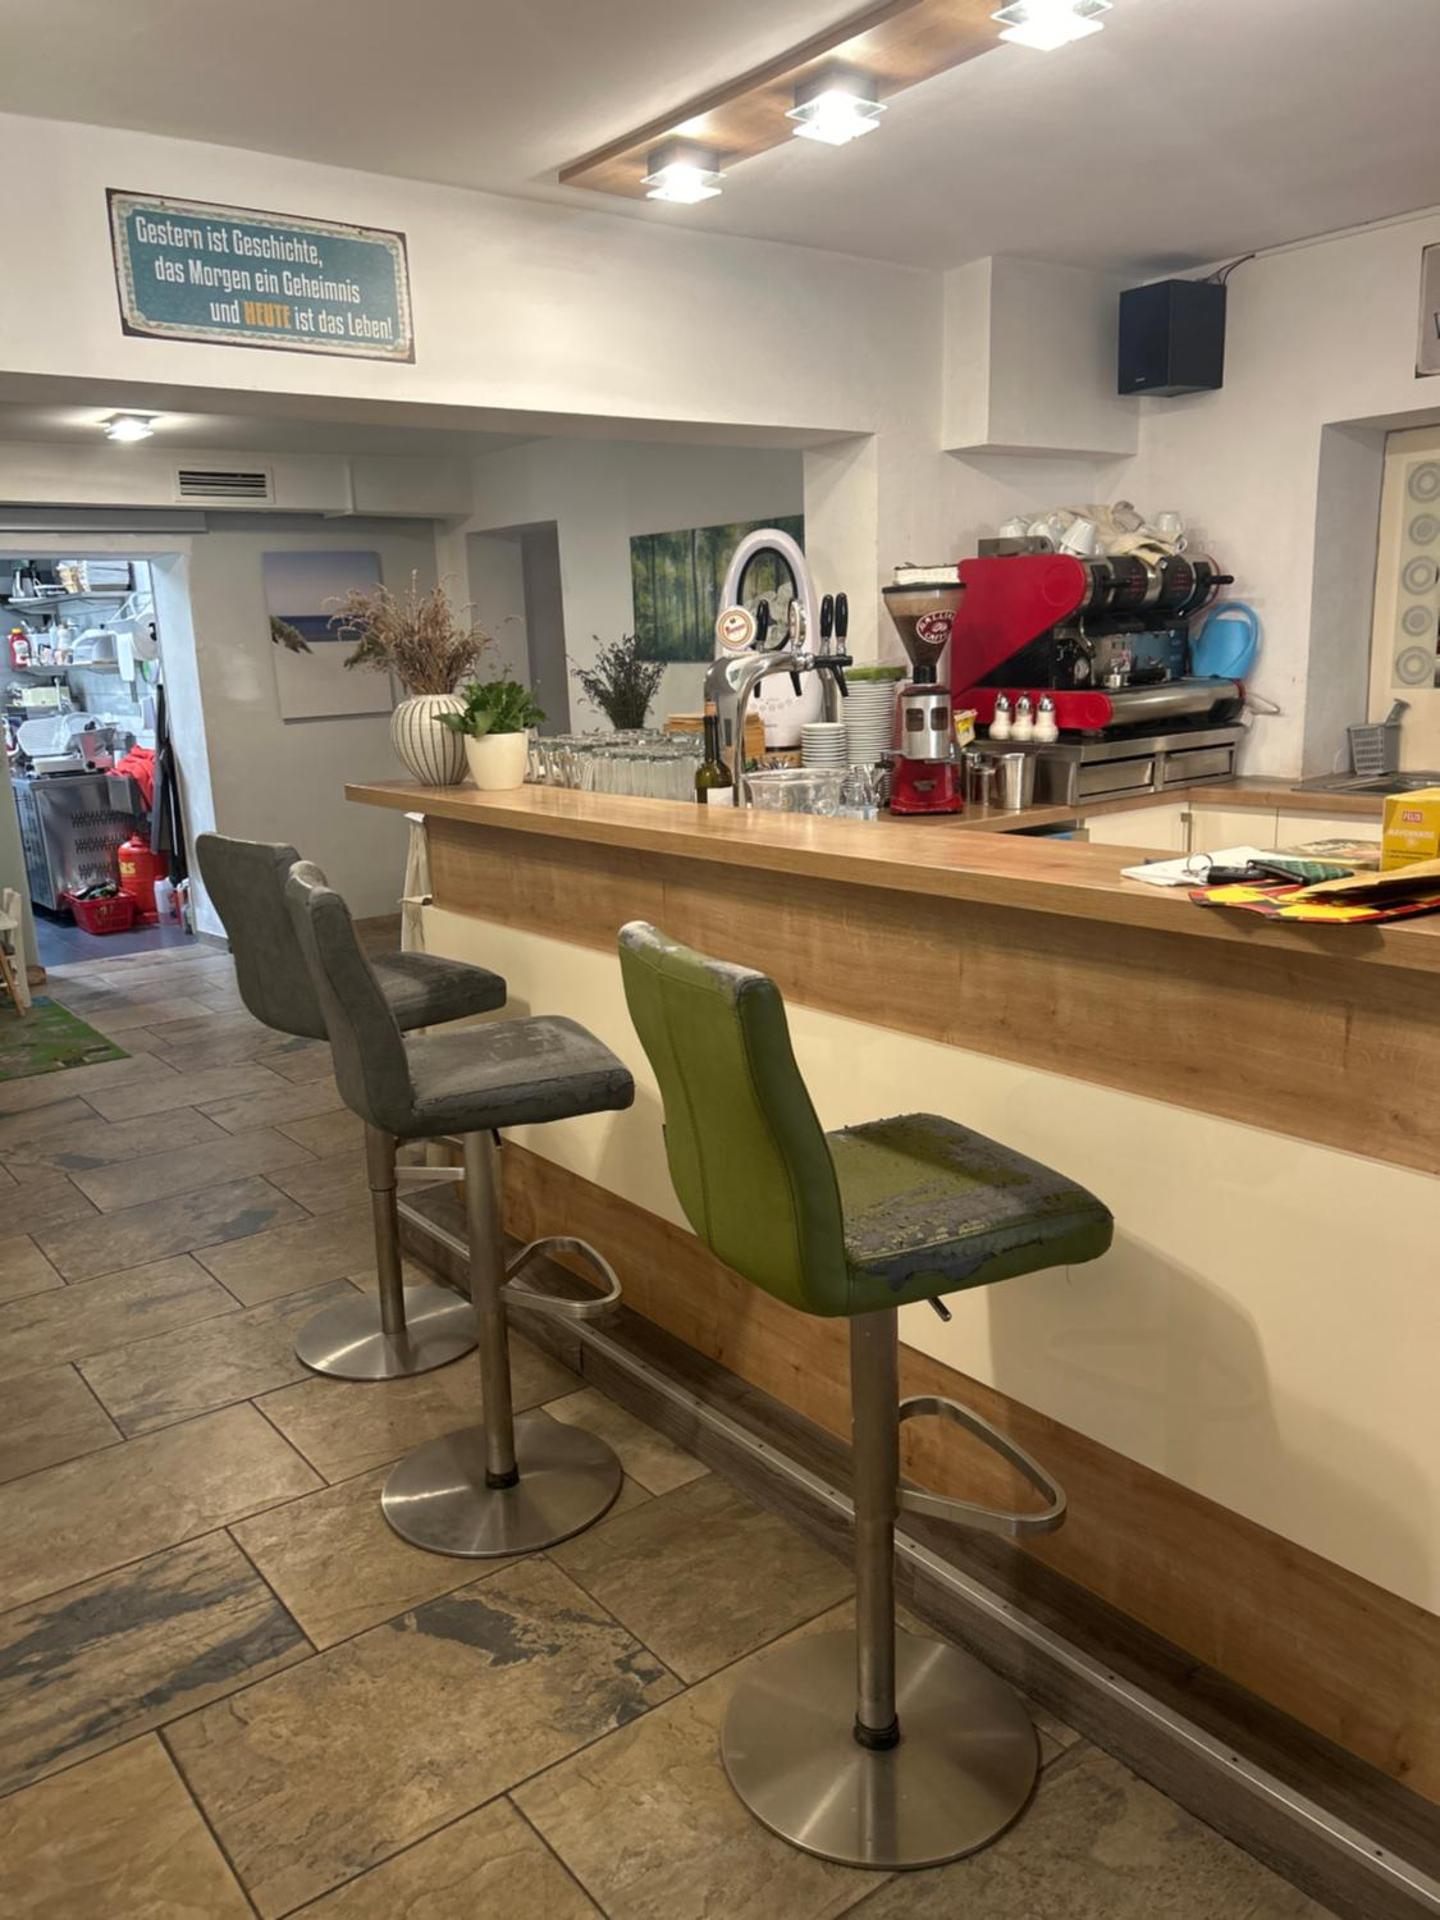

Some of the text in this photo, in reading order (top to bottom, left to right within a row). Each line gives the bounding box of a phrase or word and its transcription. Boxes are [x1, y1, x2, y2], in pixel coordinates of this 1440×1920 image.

[135, 216, 322, 268] Gestern ist Geschichte,
[155, 255, 360, 304] das Morgen ein Geheimnis
[210, 300, 393, 340] und HEUTE ist das Leben!
